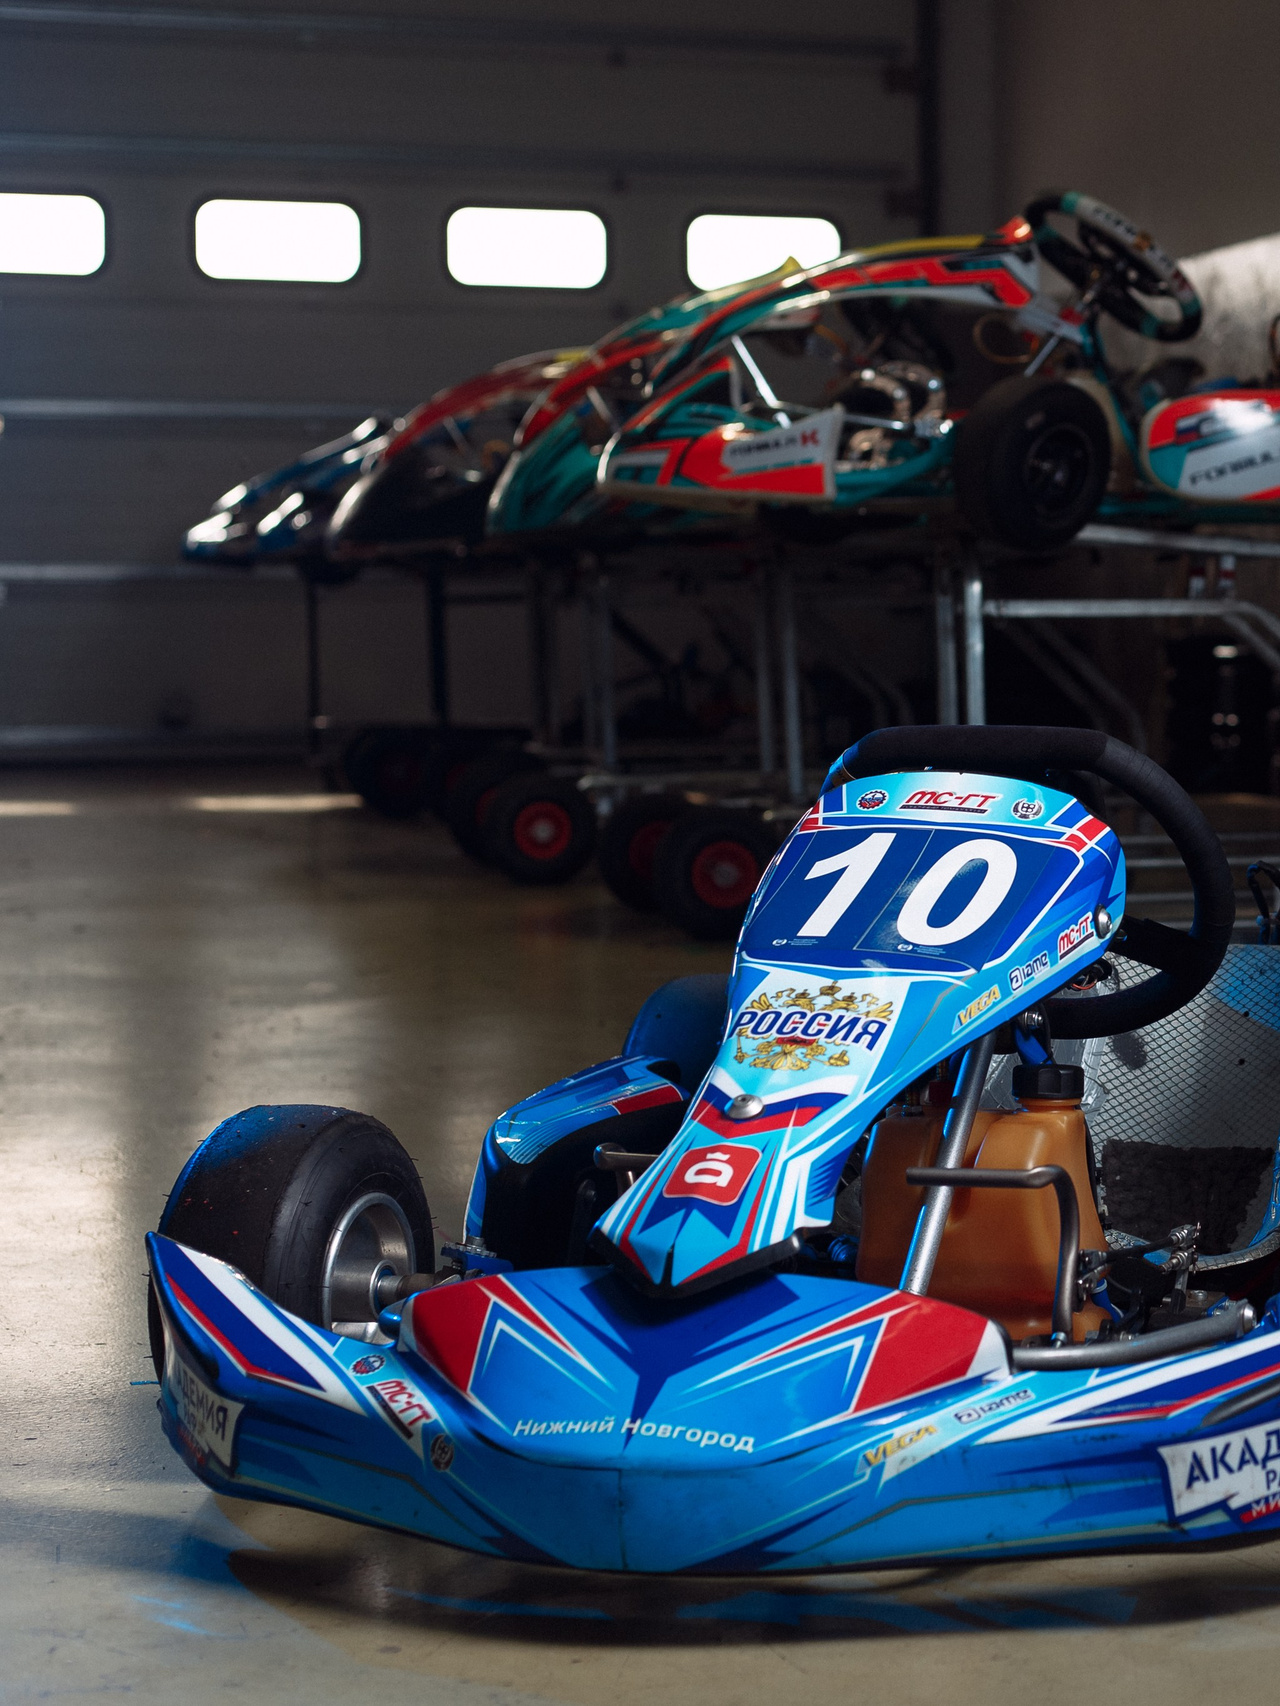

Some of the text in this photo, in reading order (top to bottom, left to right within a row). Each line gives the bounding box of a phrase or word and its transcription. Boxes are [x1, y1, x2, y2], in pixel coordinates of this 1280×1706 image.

[796, 832, 1018, 946] 10
[957, 985, 1000, 1026] VEGA
[729, 1010, 888, 1052] РОССИЯ
[513, 1415, 756, 1453] Нижний Новгород
[867, 1424, 938, 1466] VEGA
